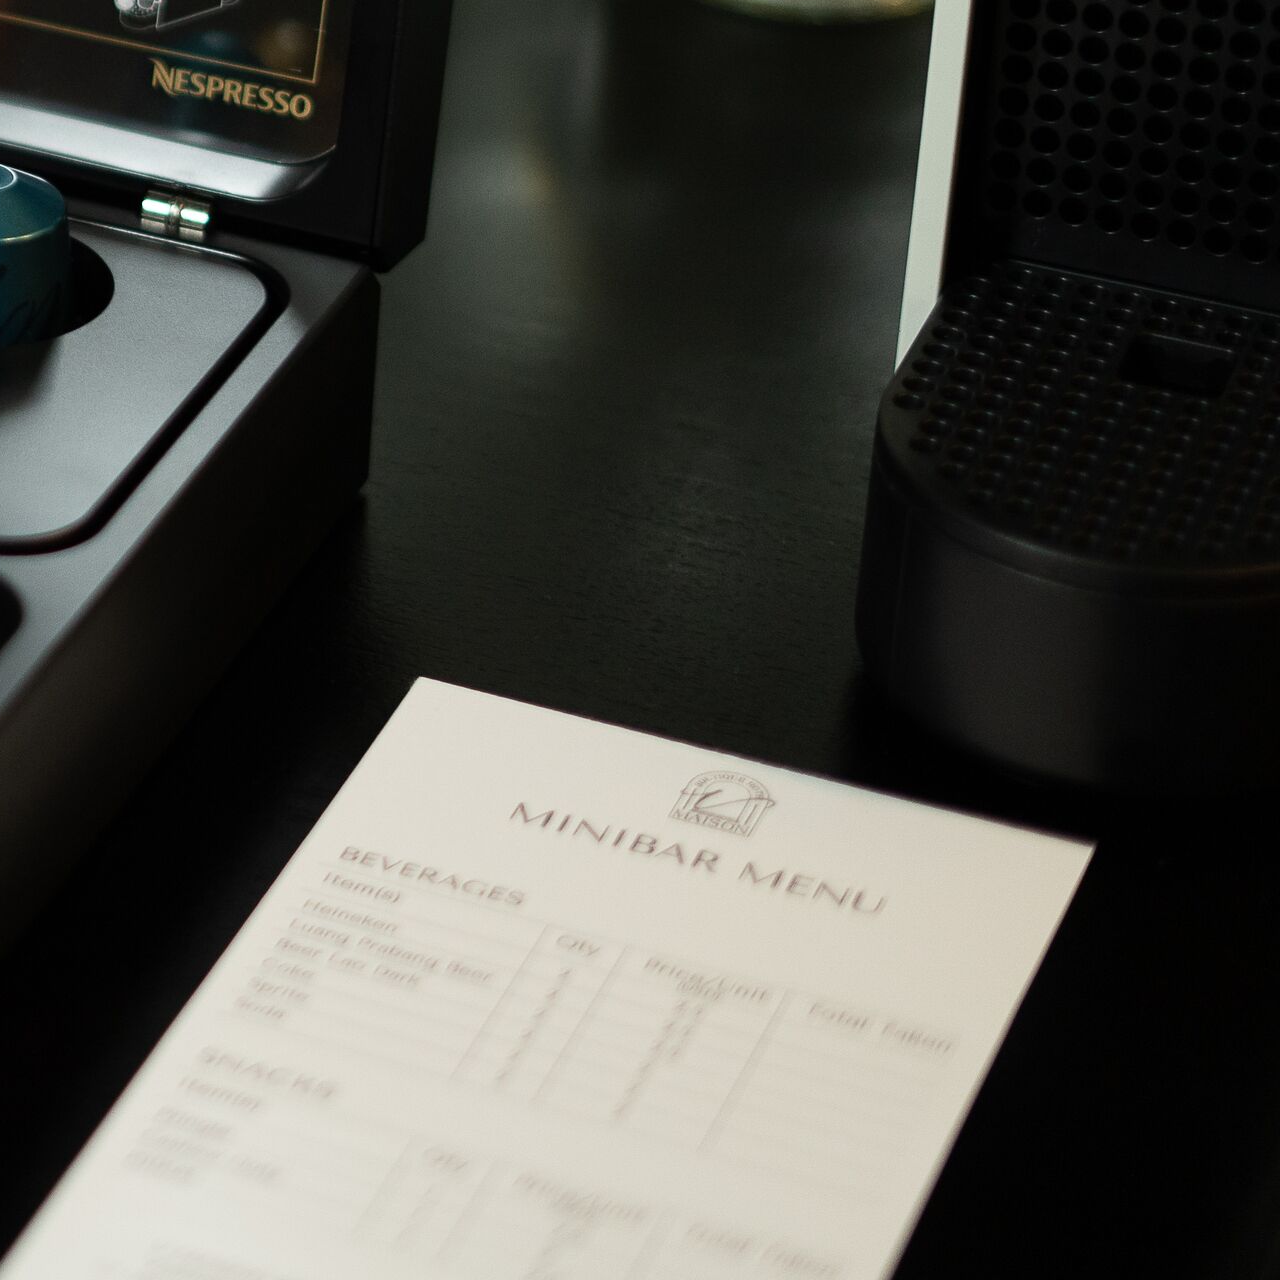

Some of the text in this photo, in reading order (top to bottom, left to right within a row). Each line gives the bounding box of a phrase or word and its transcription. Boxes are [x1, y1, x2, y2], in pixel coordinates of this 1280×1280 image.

[151, 58, 312, 119] NESPRESSO
[672, 807, 752, 836] MAISON
[339, 845, 525, 907] BEVERAGES
[510, 801, 888, 915] MINIBAR MENU
[323, 872, 402, 904] Item(s)
[303, 899, 399, 933] Heineken
